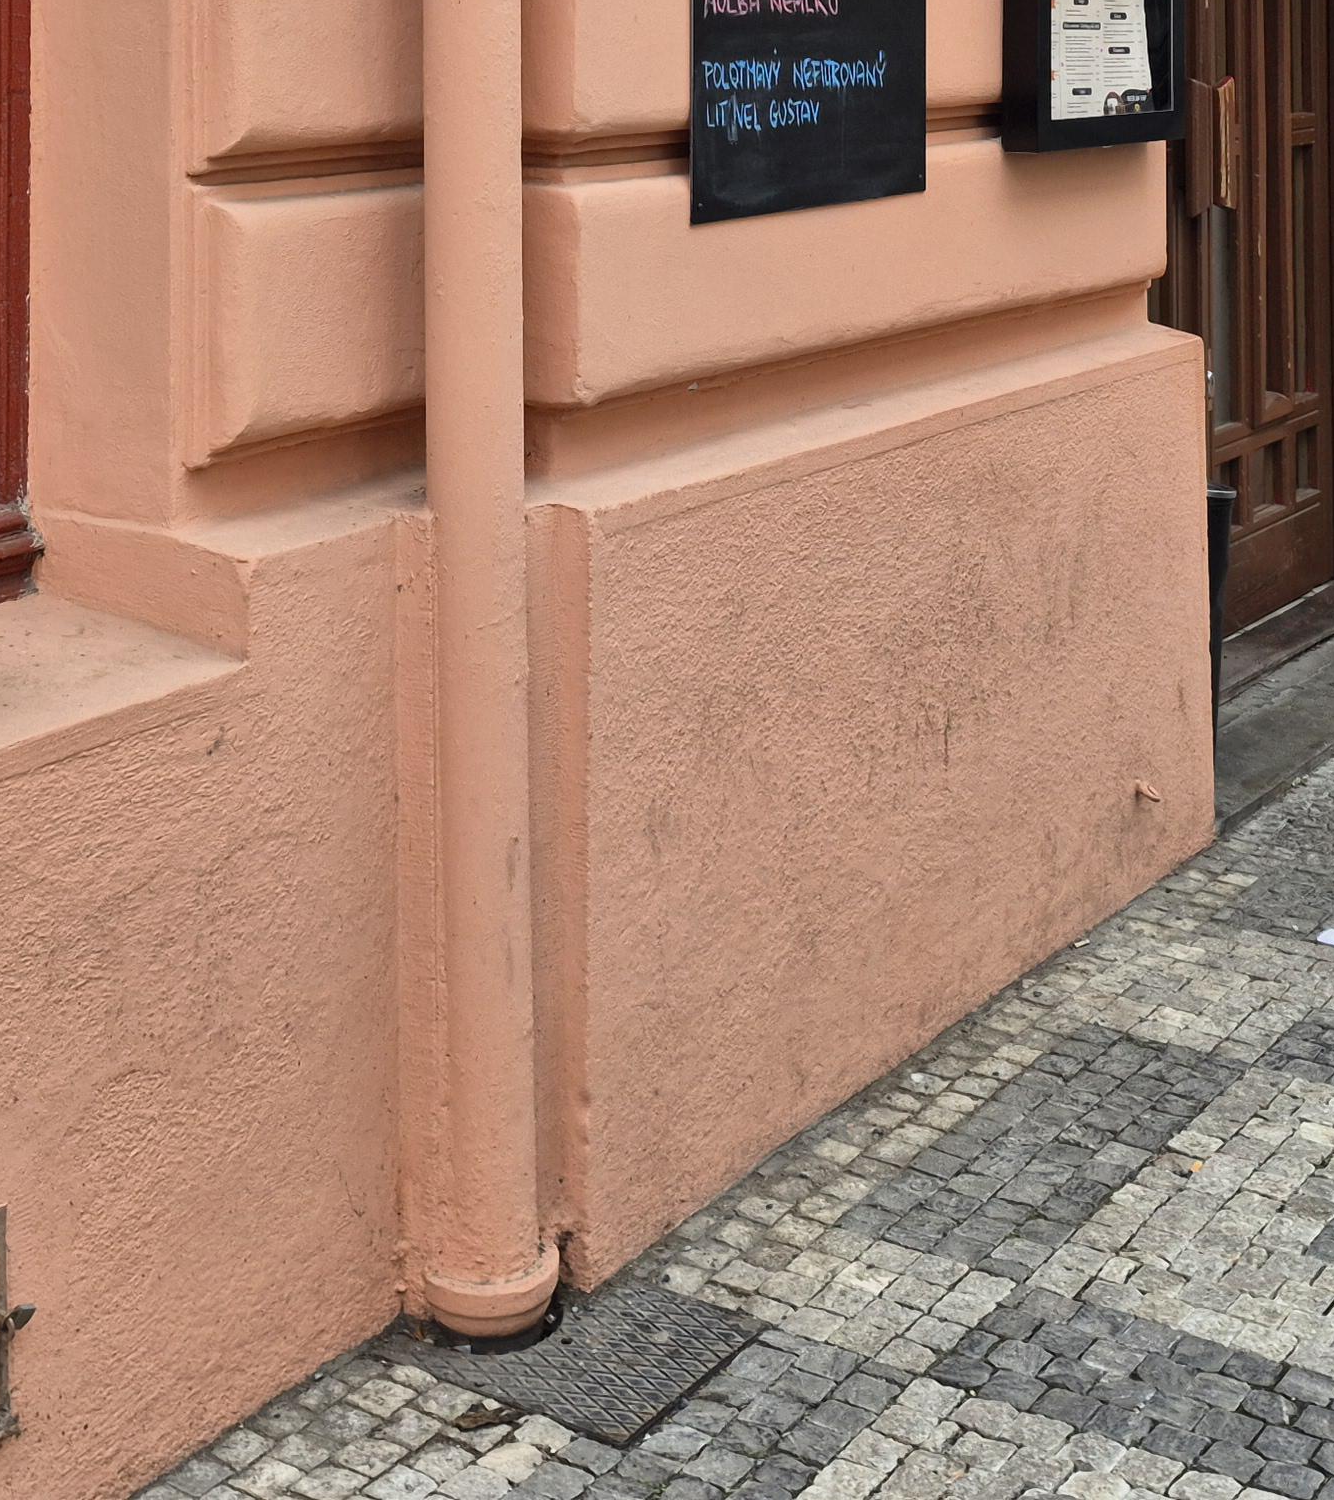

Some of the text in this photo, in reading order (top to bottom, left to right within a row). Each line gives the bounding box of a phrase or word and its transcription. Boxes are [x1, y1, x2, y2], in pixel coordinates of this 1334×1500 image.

[702, 48, 887, 91] POLOTMAVÝ NEFILTROVANÝ
[769, 98, 820, 129] GUSTAV
